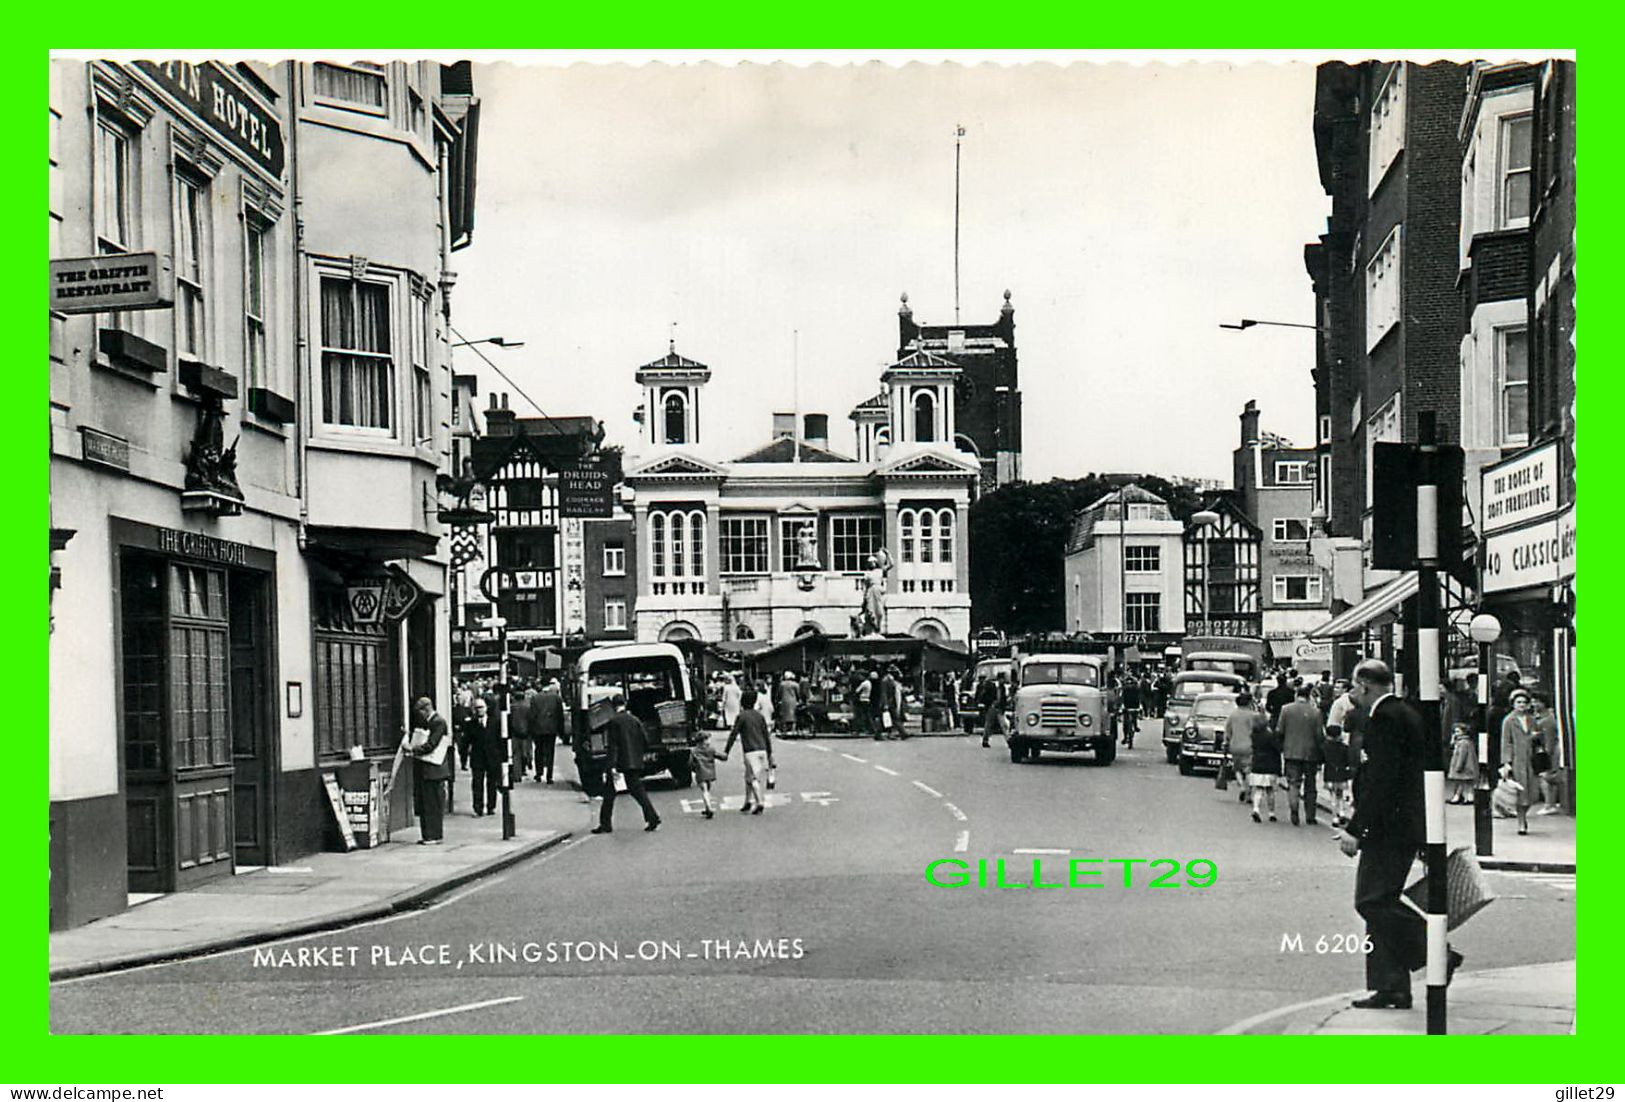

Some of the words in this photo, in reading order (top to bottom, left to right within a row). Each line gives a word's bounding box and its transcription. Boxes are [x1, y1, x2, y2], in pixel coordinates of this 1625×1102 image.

[212, 81, 271, 160] HOTEL
[57, 271, 86, 282] THE
[88, 265, 148, 280] GRIFFIN
[56, 281, 151, 298] RESTAURANT
[563, 471, 608, 479] DRUIDS
[1494, 477, 1505, 495] THE
[1534, 462, 1543, 481] OF
[570, 481, 602, 489] HEAD
[1488, 500, 1503, 519] SOFT
[161, 529, 178, 552] THE
[182, 533, 218, 559] GRIFFIN
[220, 541, 246, 565] HOTEL
[1488, 552, 1501, 576] 40
[1196, 628, 1257, 636] PERKINS
